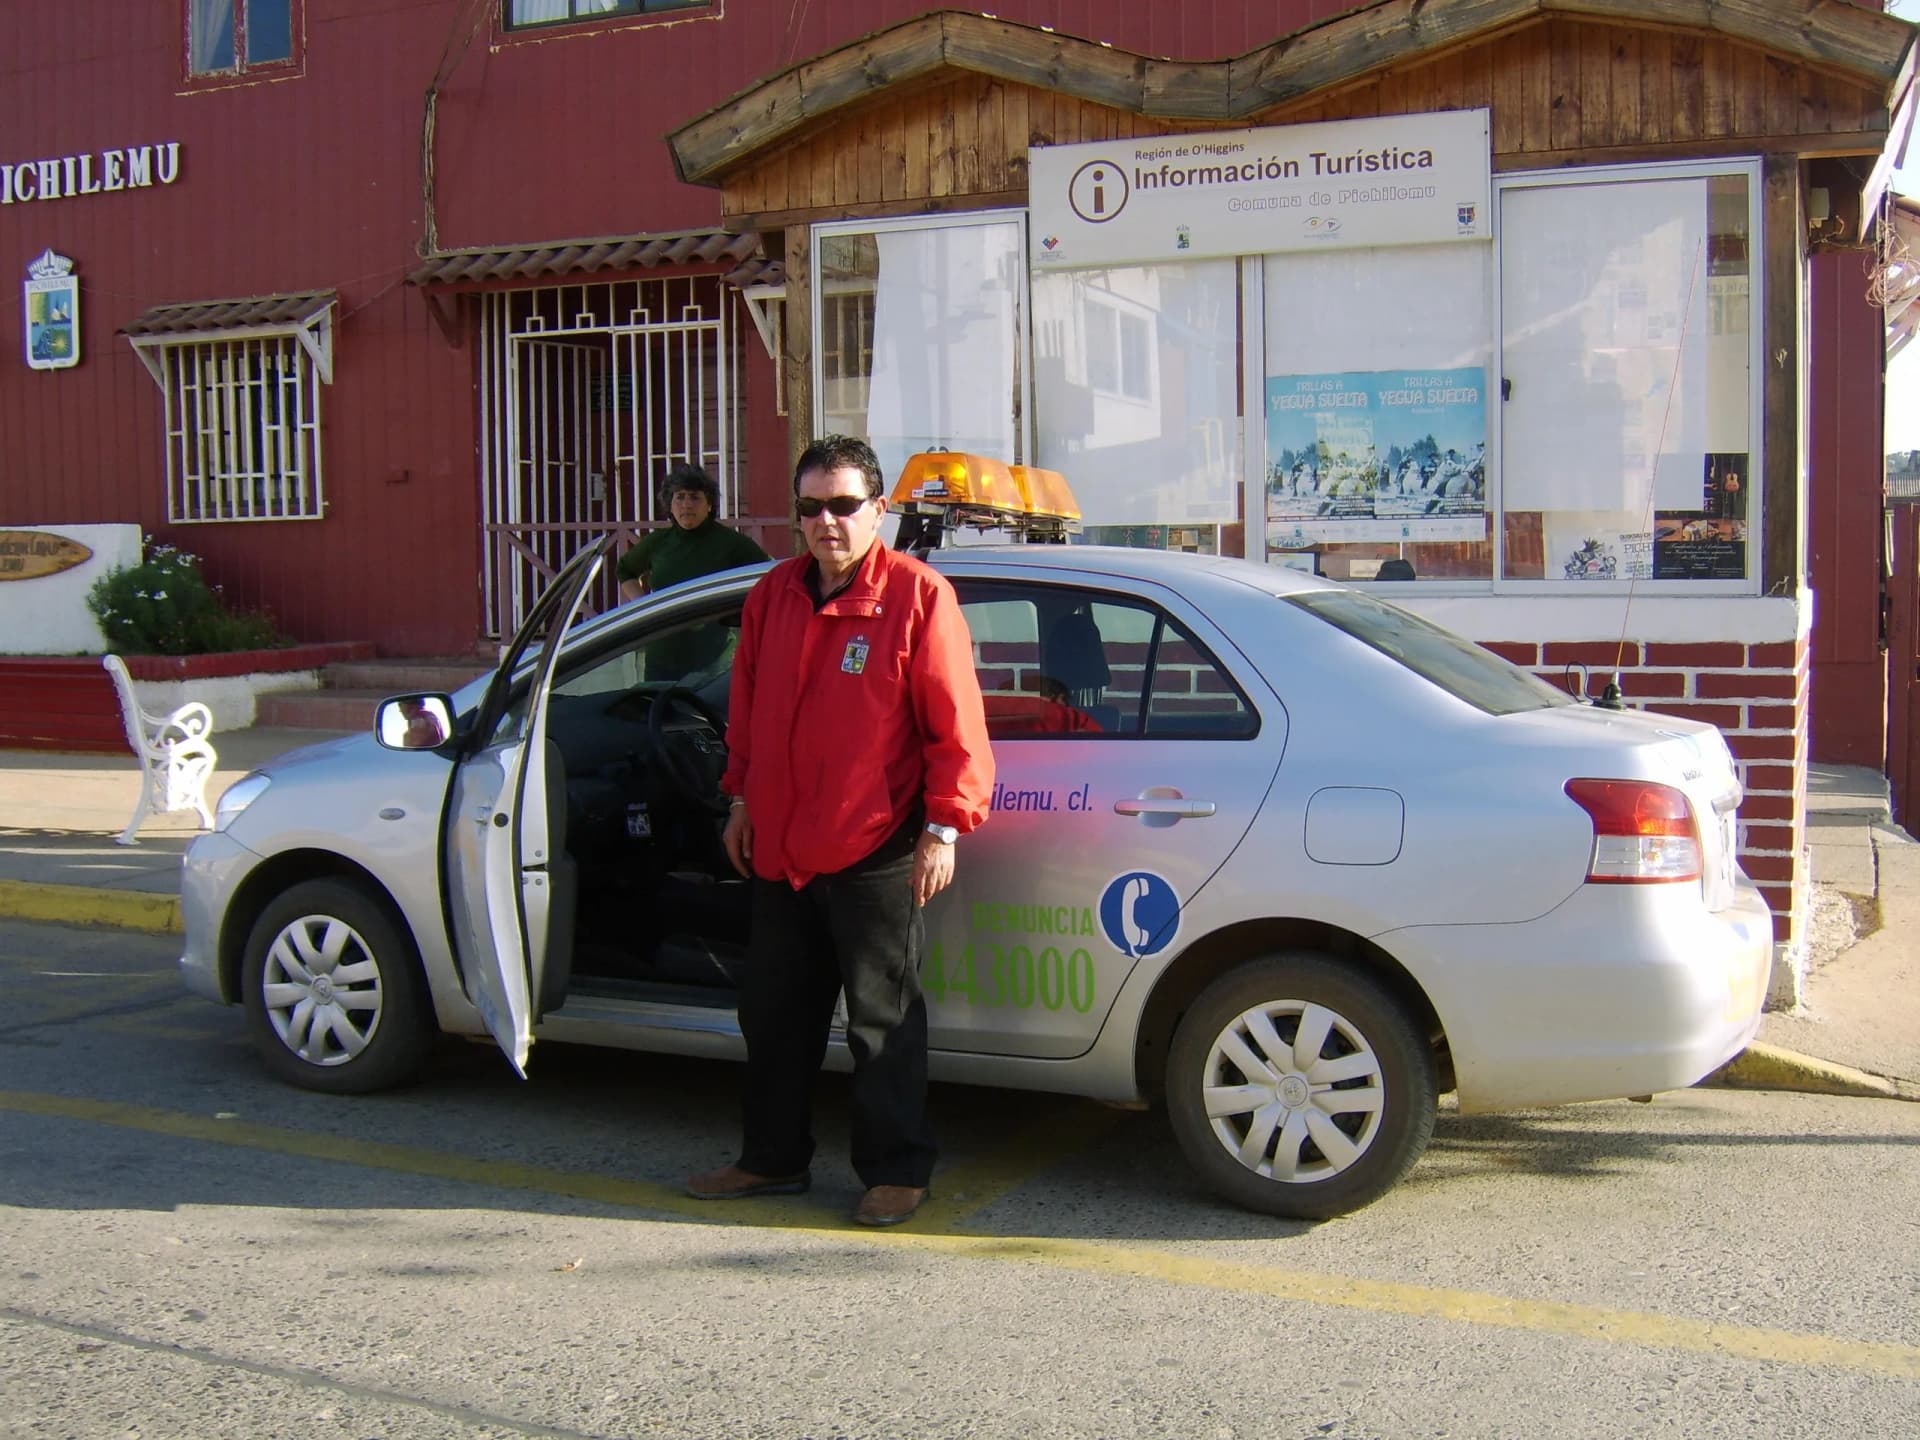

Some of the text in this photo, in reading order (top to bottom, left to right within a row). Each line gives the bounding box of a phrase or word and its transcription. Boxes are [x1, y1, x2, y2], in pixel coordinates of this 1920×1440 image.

[1135, 142, 1245, 161] Región de O'Higgins
[0, 143, 180, 204] ICHILEMU
[1135, 147, 1433, 190] Información Turística
[1228, 185, 1436, 212] Comuna de Pichilemu
[1296, 380, 1334, 392] TRILLAS
[1405, 376, 1452, 388] TRILLAS A
[1271, 391, 1368, 409] YEGUA SUELTA
[1379, 387, 1478, 405] YEGUA SUELTA
[1068, 783, 1093, 811] cl.
[971, 902, 1095, 937] DENUNCIA
[920, 942, 1095, 1015] 443000
